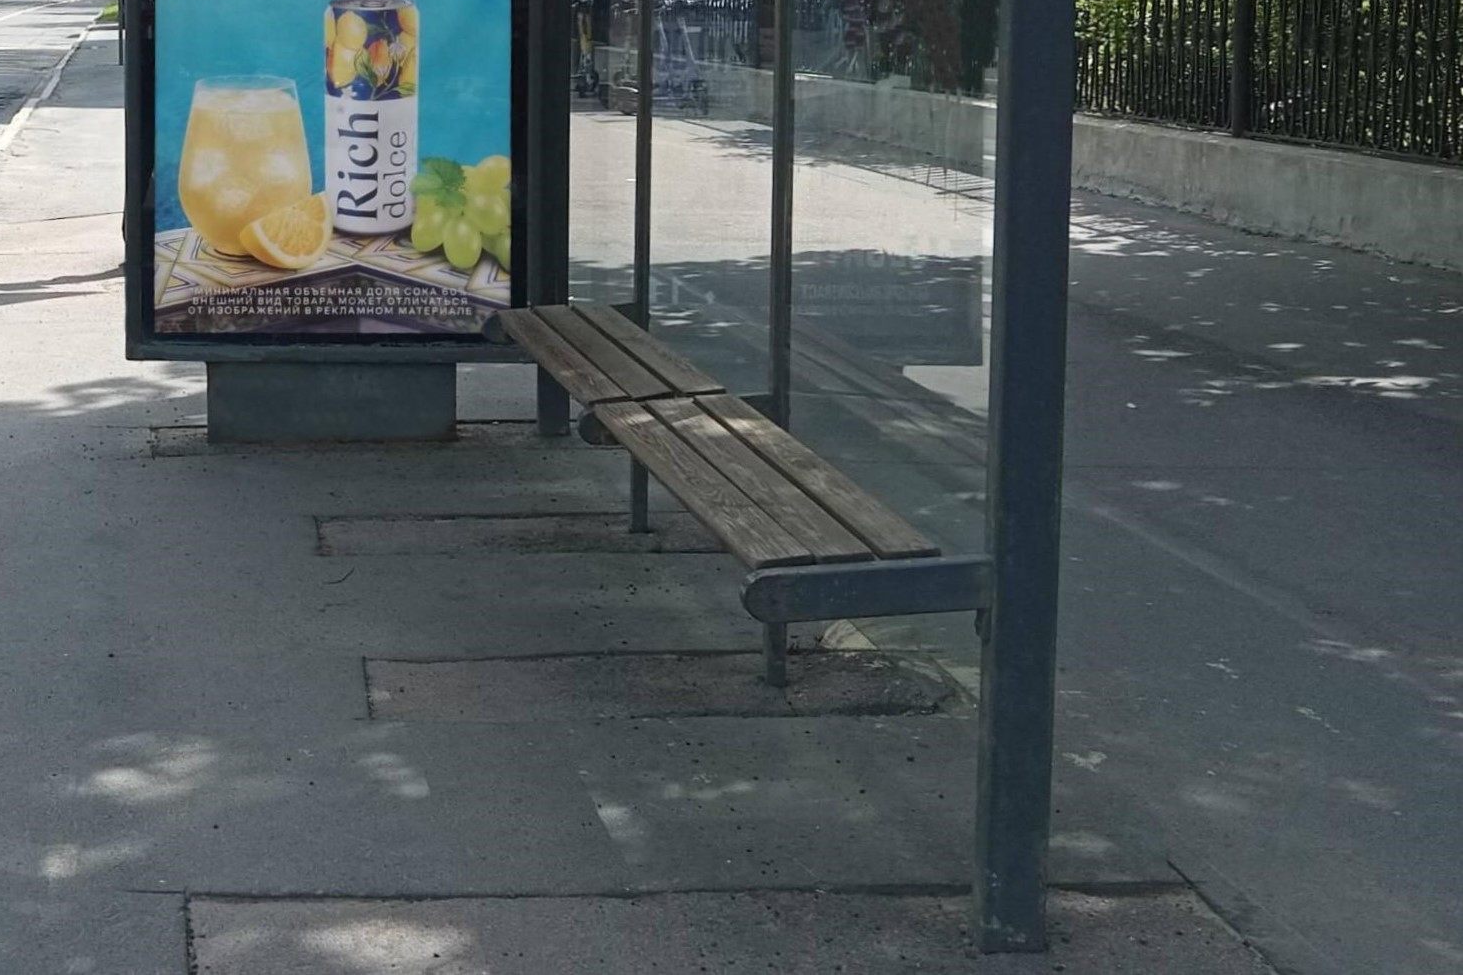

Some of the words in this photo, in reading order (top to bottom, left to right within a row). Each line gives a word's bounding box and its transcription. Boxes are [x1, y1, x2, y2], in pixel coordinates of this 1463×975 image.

[337, 110, 379, 220] Rich
[382, 131, 408, 219] dolce
[293, 287, 362, 296] ОБЪЕМНАЯ
[366, 287, 400, 297] ДОЛЯ
[403, 287, 437, 296] СОКА
[192, 296, 253, 305] ВНЕШНИЙ
[257, 297, 282, 306] ВИД
[286, 297, 334, 305] ТОВАРА
[338, 297, 383, 305] МОЖЕТ
[386, 297, 469, 305] ОТЛИЧАТЬСЯ
[187, 306, 203, 315] ОТ
[207, 305, 301, 315] ИЗОБРАЖЕНИЙ
[304, 306, 312, 315] В
[316, 306, 394, 315] РЕКЛАМНОМ
[398, 306, 473, 316] МАТЕРИАЛЕ
